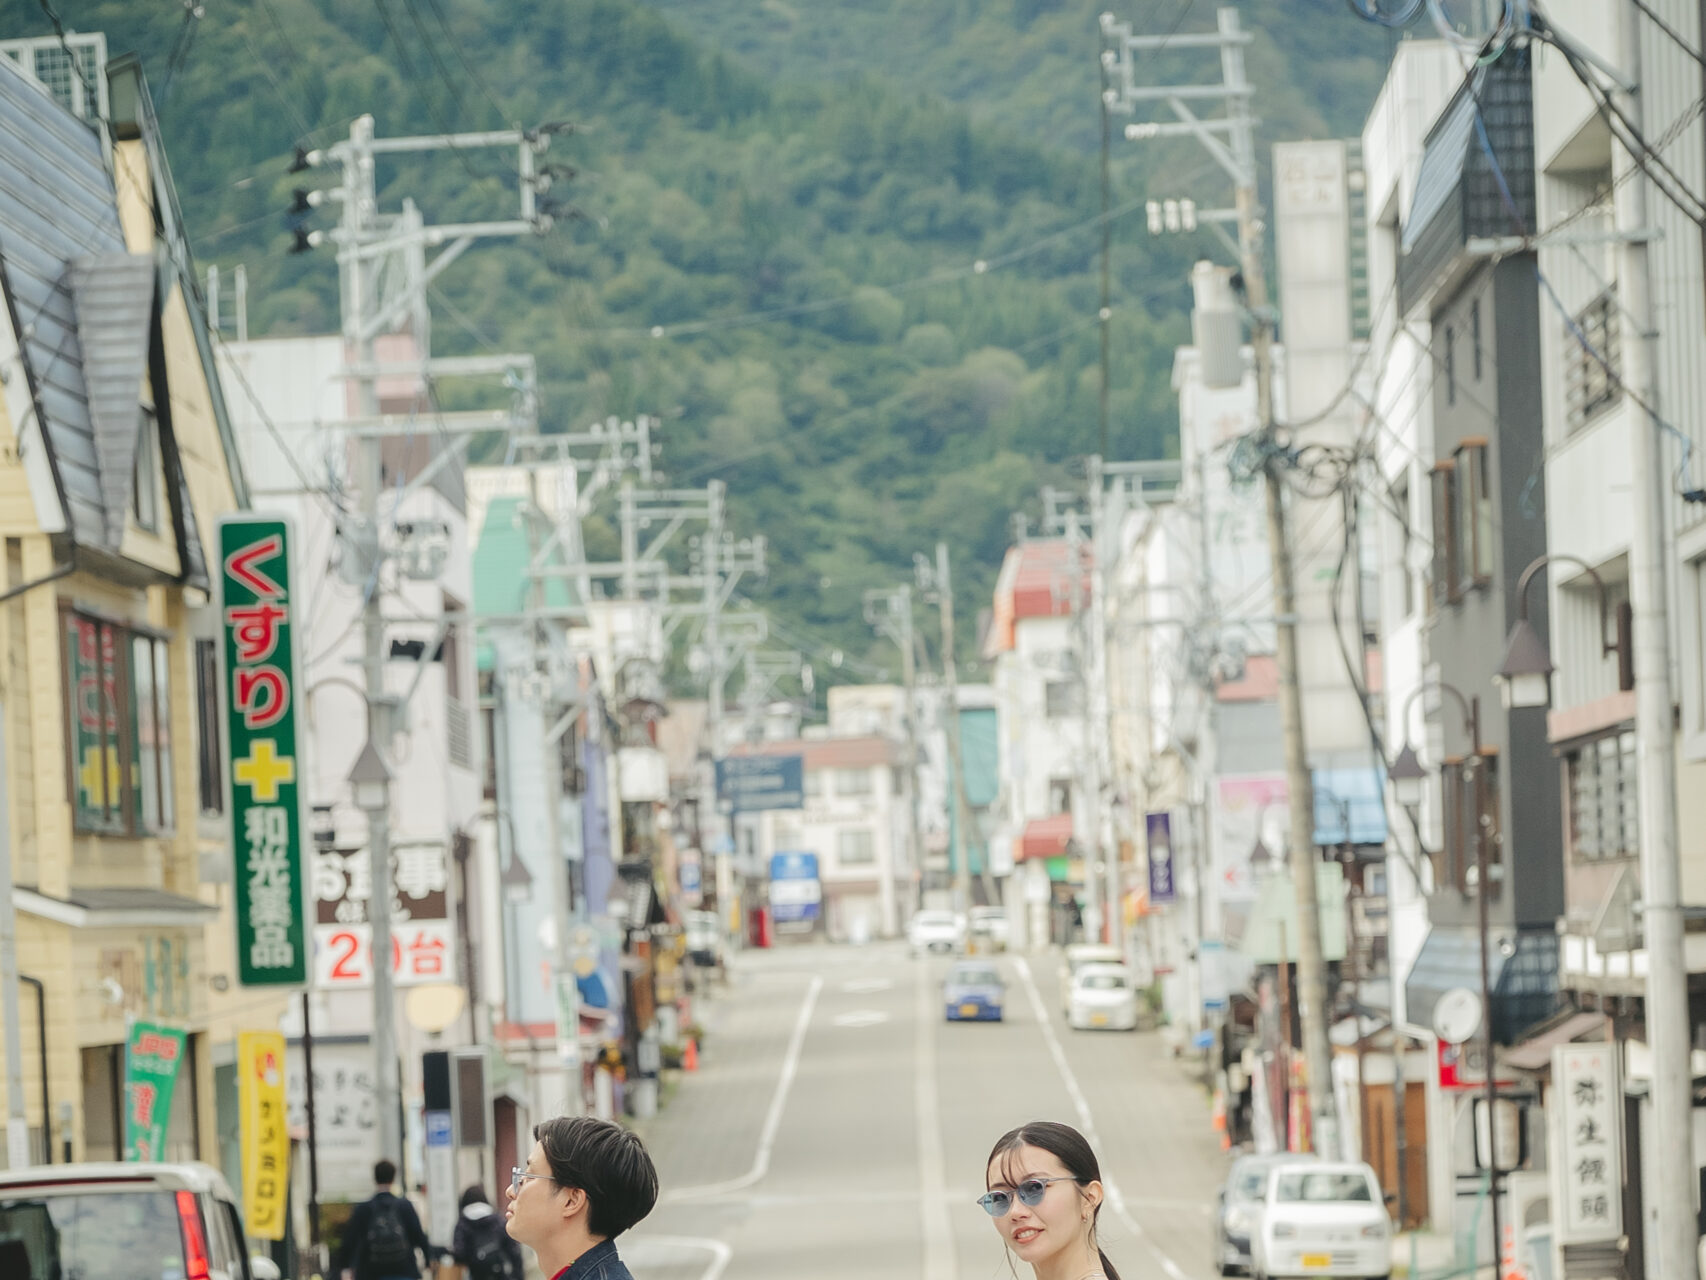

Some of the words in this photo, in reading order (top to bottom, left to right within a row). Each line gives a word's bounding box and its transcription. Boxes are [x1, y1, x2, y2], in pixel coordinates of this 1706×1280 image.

[225, 533, 290, 729] くすり
[244, 805, 294, 968] 和光薬品
